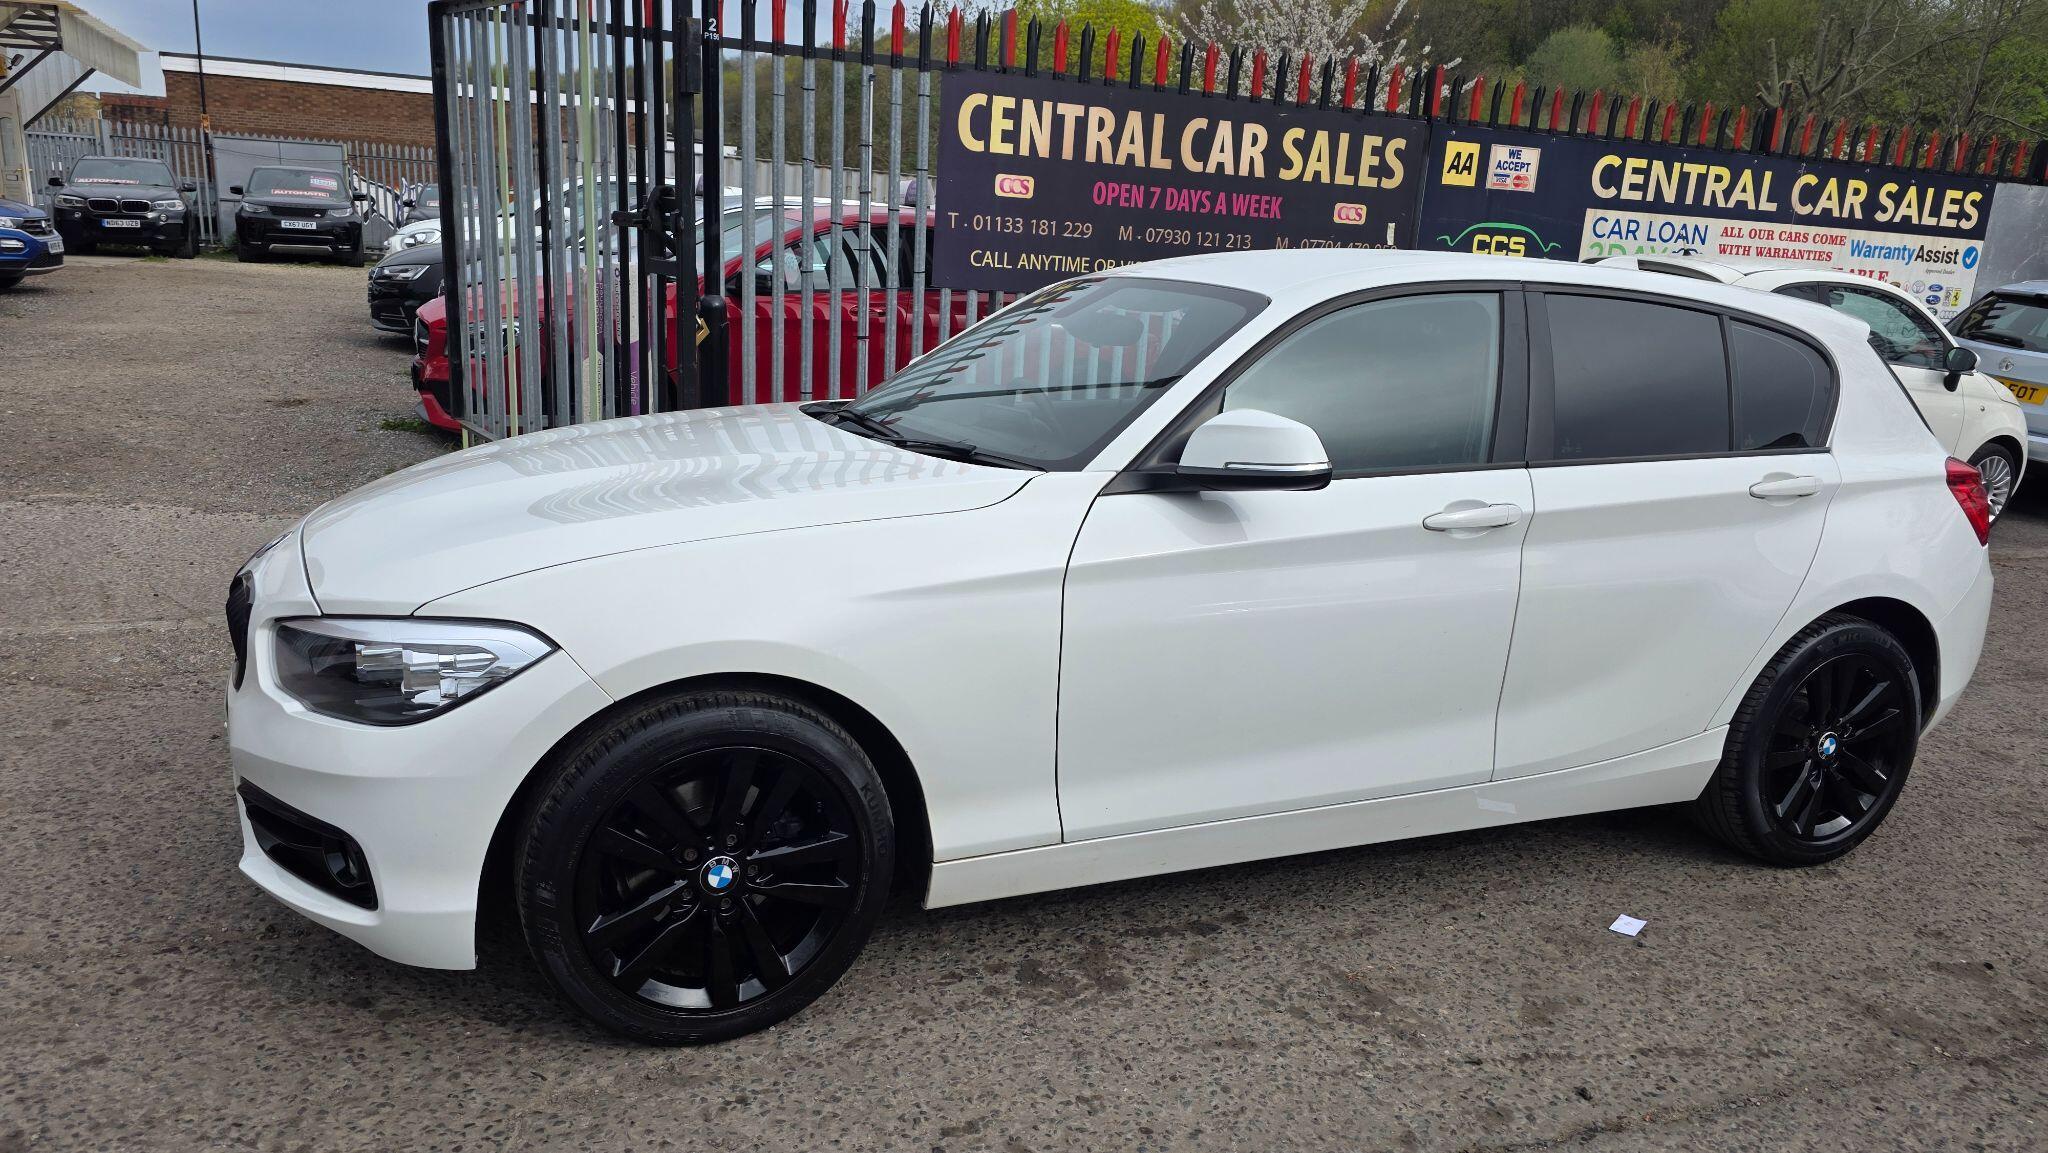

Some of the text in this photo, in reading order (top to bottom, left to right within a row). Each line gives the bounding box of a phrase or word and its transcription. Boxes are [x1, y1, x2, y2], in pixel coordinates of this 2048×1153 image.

[708, 18, 717, 31] 2
[958, 93, 1407, 189] CENTRAL CAR SALES
[1447, 152, 1474, 175] AA
[1496, 160, 1531, 172] ACCEPT
[1508, 149, 1522, 160] WE
[1092, 181, 1283, 219] OPEN 7 DAYS A WEEK
[1591, 154, 1983, 230] CENTRAL CAR SALES
[973, 214, 1023, 234] 01133
[1031, 219, 1056, 236] 181
[1064, 221, 1093, 238] 229
[1592, 216, 1709, 246] CAR LOAN
[1720, 226, 1847, 246] ALL OUR CARS COME
[1146, 227, 1190, 245] 07930
[1197, 231, 1219, 247] 121
[1226, 233, 1251, 249] 213
[1472, 234, 1526, 258] CCS
[970, 250, 1012, 269] CALL
[1017, 253, 1090, 273] ANYTIME
[1094, 259, 1116, 273] OR
[1718, 243, 1833, 262] WITH WARRANTIES
